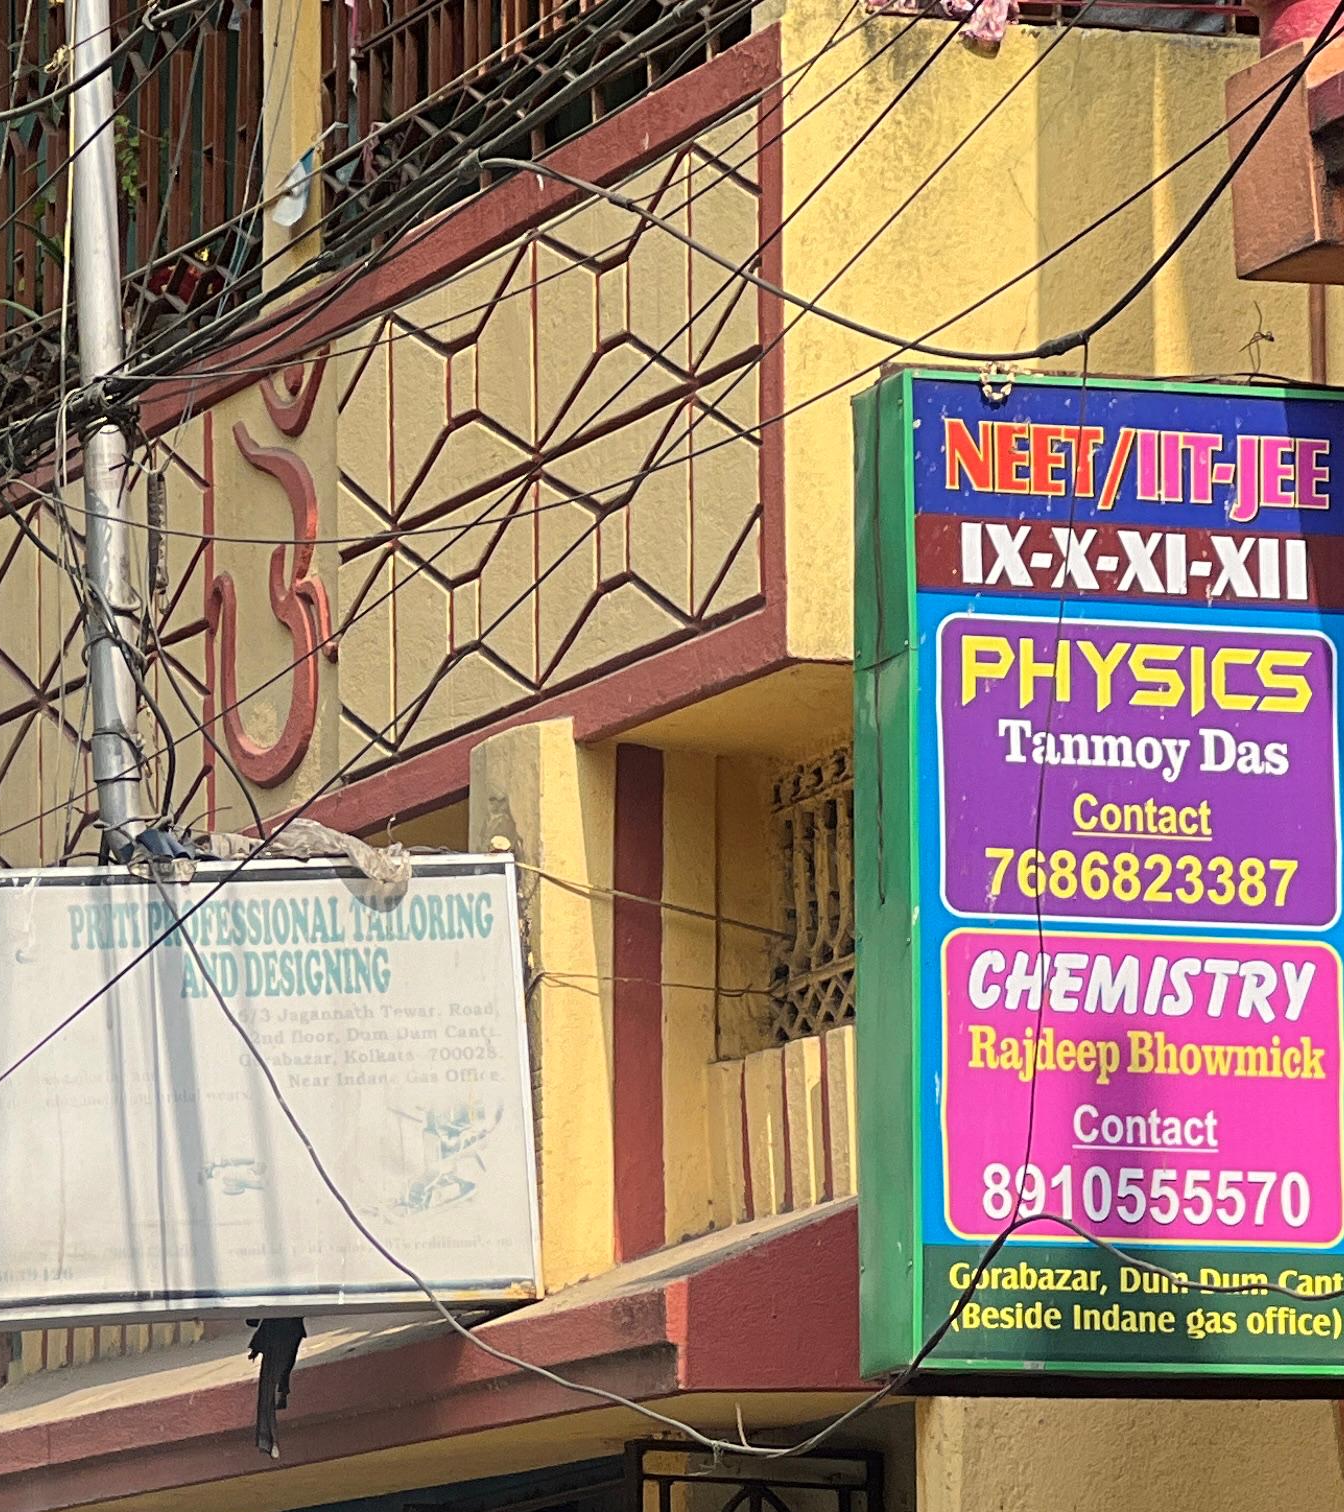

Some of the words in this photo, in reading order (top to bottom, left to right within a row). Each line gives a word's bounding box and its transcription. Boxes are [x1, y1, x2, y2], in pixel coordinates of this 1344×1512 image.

[945, 418, 1330, 521] NEET/IIT-JEE
[961, 522, 1308, 599] IX-X-XI-XII
[961, 634, 1313, 717] PHYSICS
[998, 719, 1190, 781] Tanmoy
[1200, 728, 1289, 775] Das
[1073, 793, 1212, 836] Contact
[985, 848, 1298, 906] 7686823387
[68, 901, 138, 949] PRITI
[148, 896, 346, 947] PROFESSIONAL
[351, 892, 494, 943] TAILORING
[180, 950, 239, 999] AND
[244, 947, 391, 998] DESIGNING
[968, 949, 1316, 1023] CHEMISTRY
[289, 1073, 330, 1088] Near
[337, 1071, 397, 1086] Indan
[968, 1025, 1121, 1085] Rajdeep
[1127, 1030, 1325, 1079] Bhowmick
[1073, 1104, 1218, 1147] Contact
[982, 1163, 1311, 1227] 8910555570
[949, 1262, 1109, 1296] Gorabazar,
[1120, 1266, 1188, 1294] Dum
[1200, 1268, 1268, 1296] Dum
[1278, 1269, 1344, 1298] Cant
[949, 1302, 1062, 1332] (Beside
[1073, 1304, 1175, 1333] Indane
[1186, 1309, 1237, 1340] gas
[1246, 1306, 1343, 1340] office)
